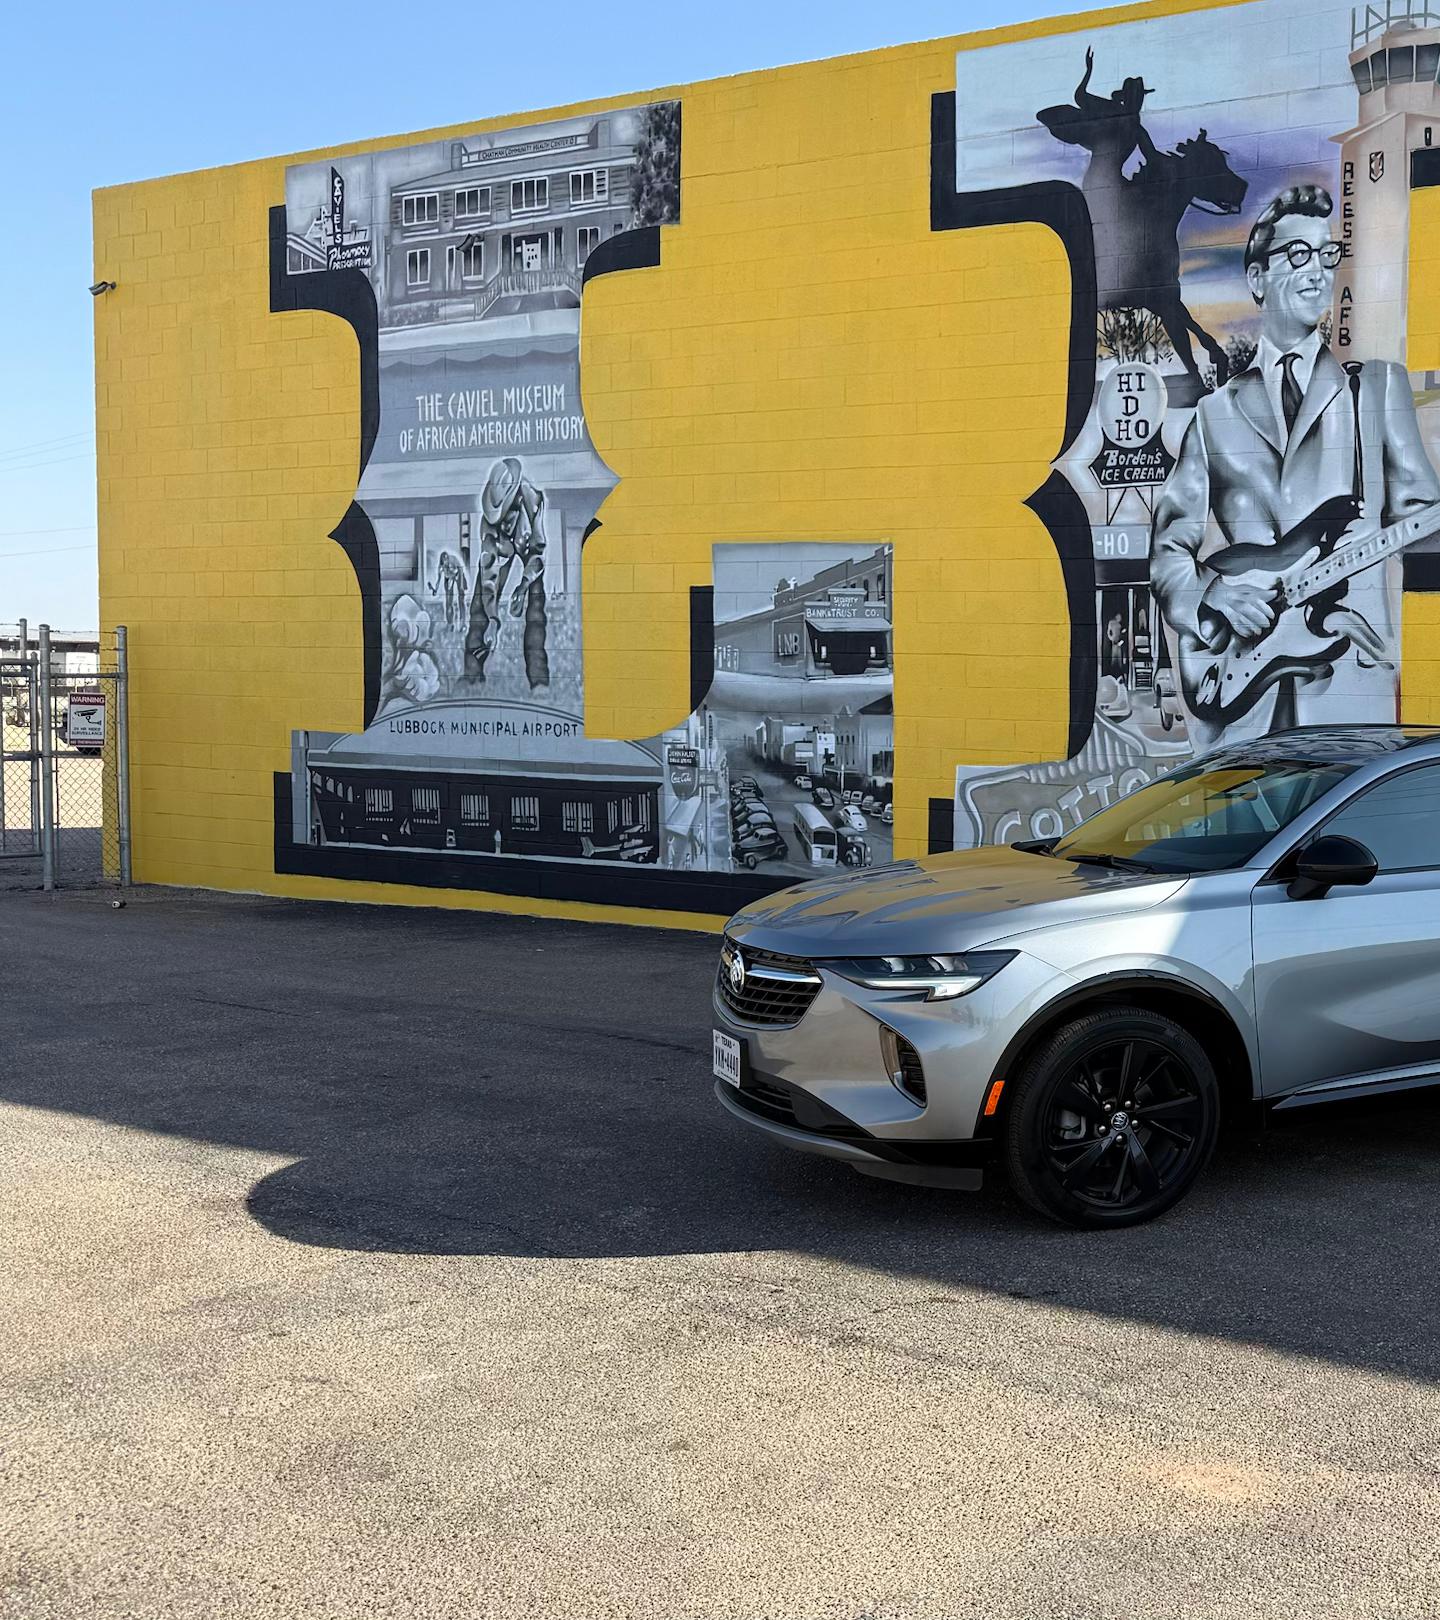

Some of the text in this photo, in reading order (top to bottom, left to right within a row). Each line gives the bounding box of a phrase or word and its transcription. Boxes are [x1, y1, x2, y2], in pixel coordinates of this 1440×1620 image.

[333, 177, 342, 244] CAVIELS
[1339, 161, 1355, 347] REESE AFB
[1117, 372, 1146, 392] HI
[416, 383, 565, 422] THE CAVIEL MUSEUM
[1122, 395, 1139, 417] D
[400, 415, 585, 454] OF AFRICAN AMERICAN HISTORY
[1115, 419, 1150, 441] HO
[1103, 448, 1162, 468] Borden's
[1101, 467, 1165, 481] ICE CREAM
[864, 609, 880, 617] CO.
[778, 632, 801, 656] LNB
[71, 696, 105, 704] WARNING
[390, 719, 578, 738] LUBBOCK MUNICIPAL AIRPORT
[993, 763, 1180, 845] COTTO
[721, 1035, 733, 1049] TEXAS
